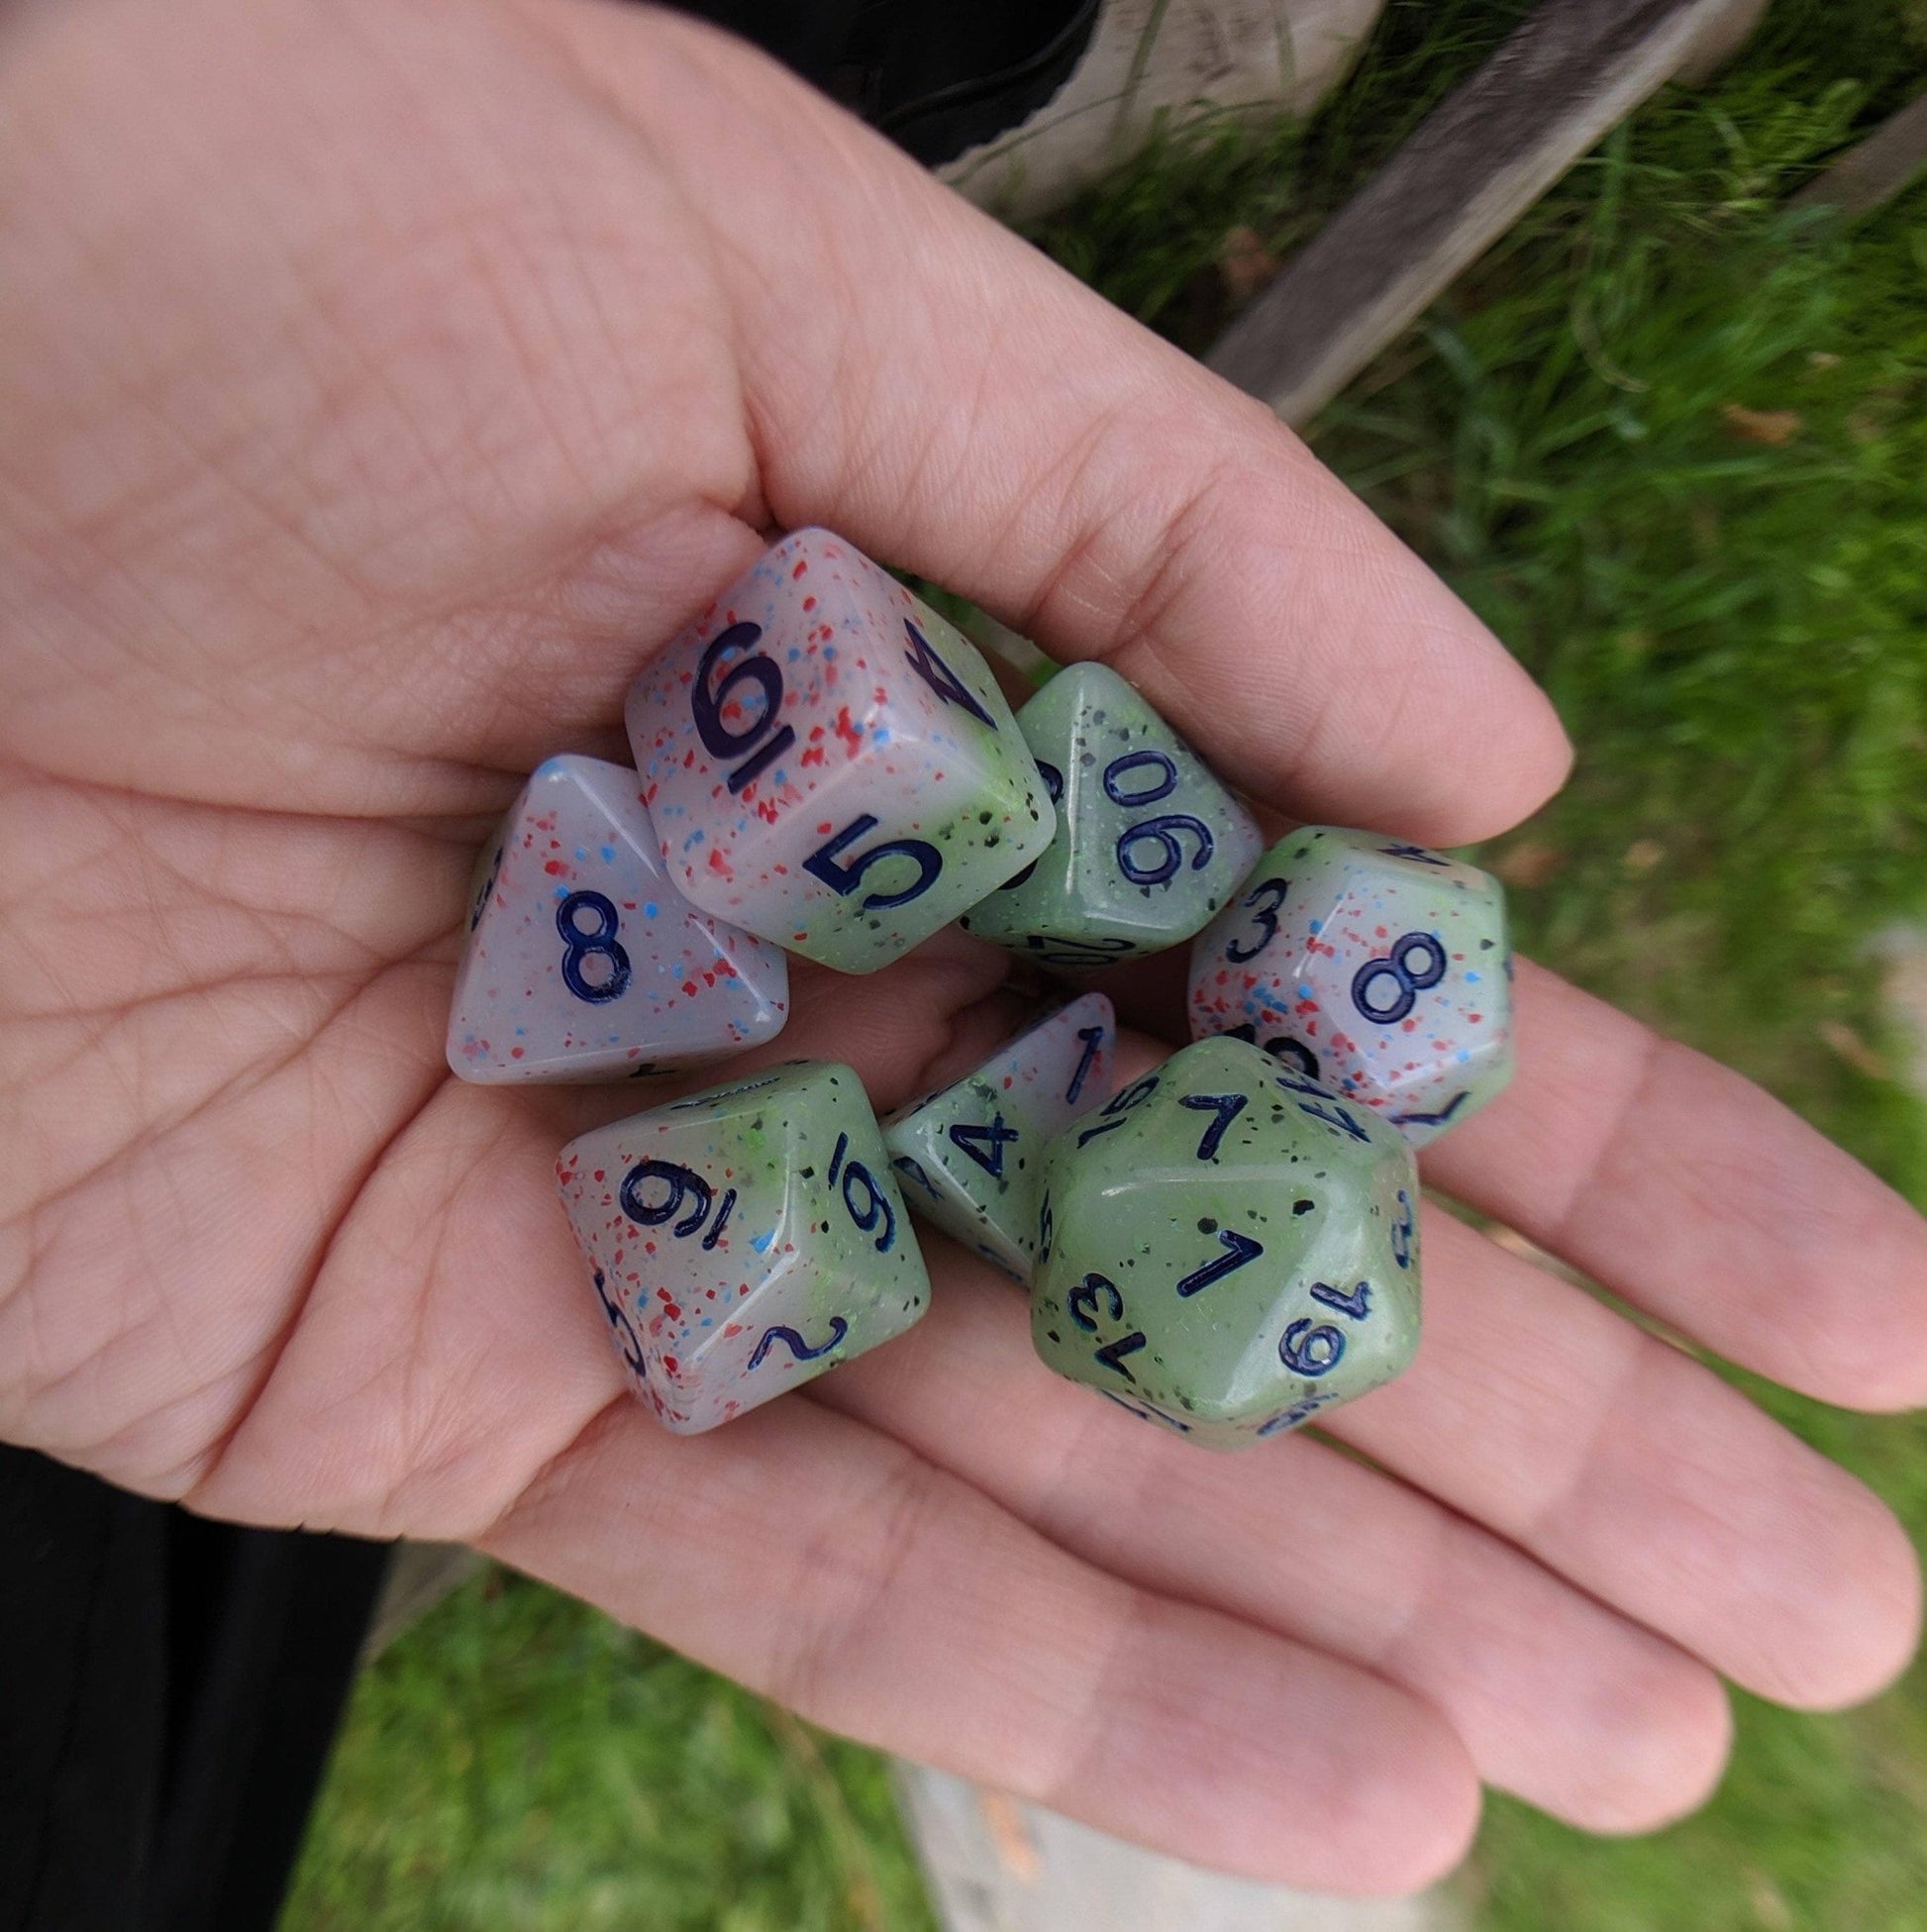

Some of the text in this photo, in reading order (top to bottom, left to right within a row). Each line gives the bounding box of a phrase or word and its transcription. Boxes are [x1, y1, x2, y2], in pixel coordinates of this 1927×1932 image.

[691, 621, 796, 795] 6
[903, 617, 999, 732] 4
[802, 813, 944, 911] 5
[556, 889, 632, 1005] 8
[1225, 876, 1288, 964] 3
[1350, 931, 1448, 1026] 8
[1065, 1025, 1105, 1106] 1
[949, 1113, 1020, 1177] 4
[1178, 1093, 1249, 1161] 7
[620, 1159, 738, 1251] 9
[1066, 1271, 1148, 1384] 13
[1277, 1279, 1374, 1377] 19
